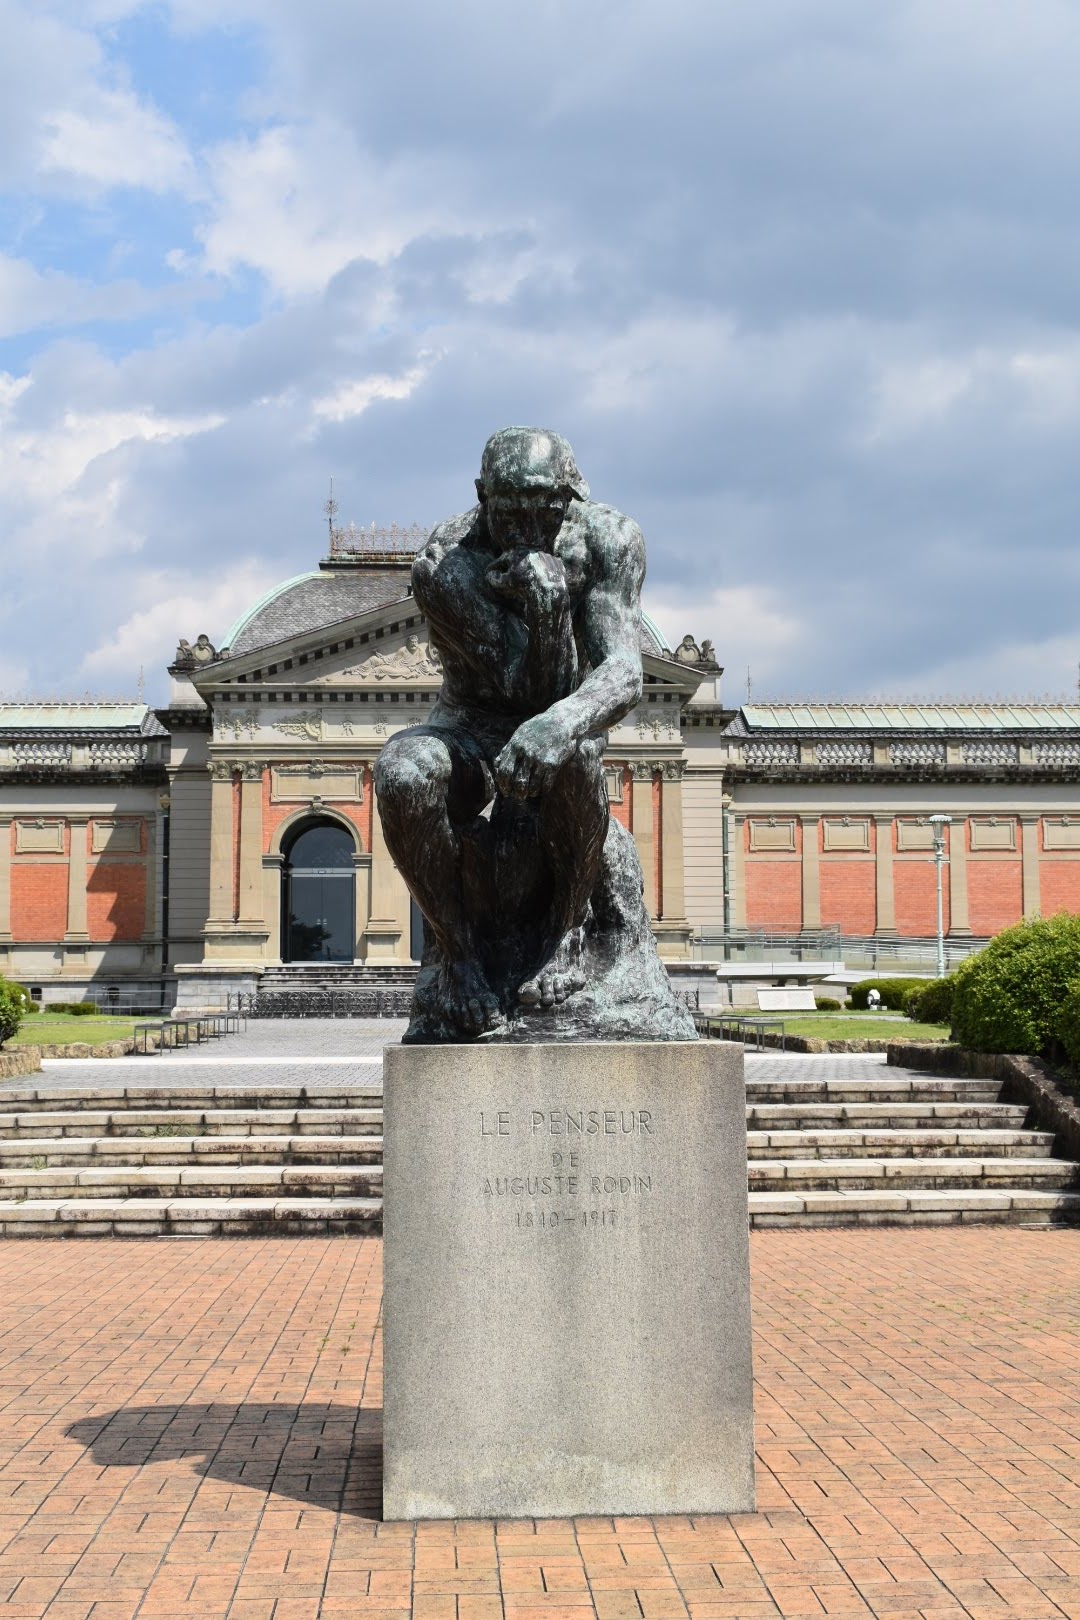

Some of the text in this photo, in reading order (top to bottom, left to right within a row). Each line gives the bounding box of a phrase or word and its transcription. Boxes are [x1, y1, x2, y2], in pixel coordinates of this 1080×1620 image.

[479, 1110, 654, 1136] LE PENSEUR
[551, 1151, 580, 1168] DE
[482, 1174, 653, 1196] AUGUSTE RODIN
